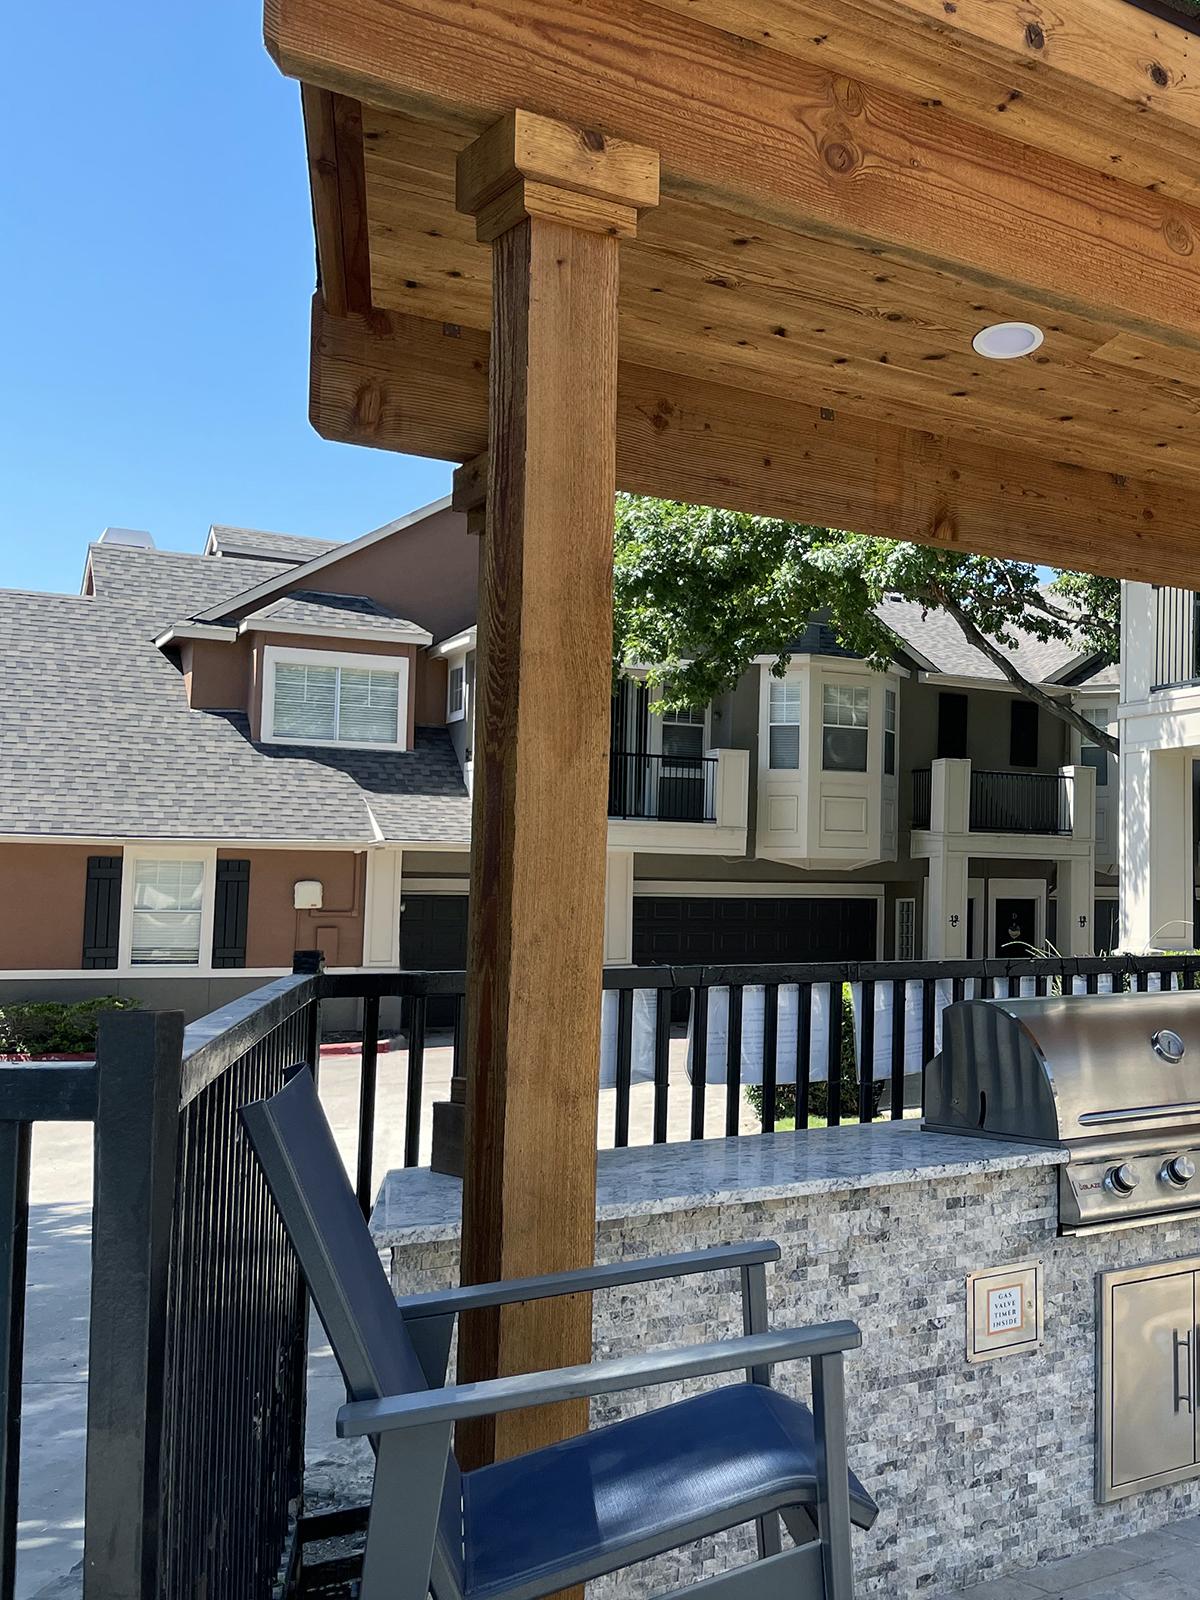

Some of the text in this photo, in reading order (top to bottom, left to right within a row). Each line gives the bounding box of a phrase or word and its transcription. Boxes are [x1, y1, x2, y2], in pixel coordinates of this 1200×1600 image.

[995, 1300, 1015, 1309] VALVE
[994, 1310, 1016, 1318] TIMER
[993, 1318, 1017, 1328] INSIDE
